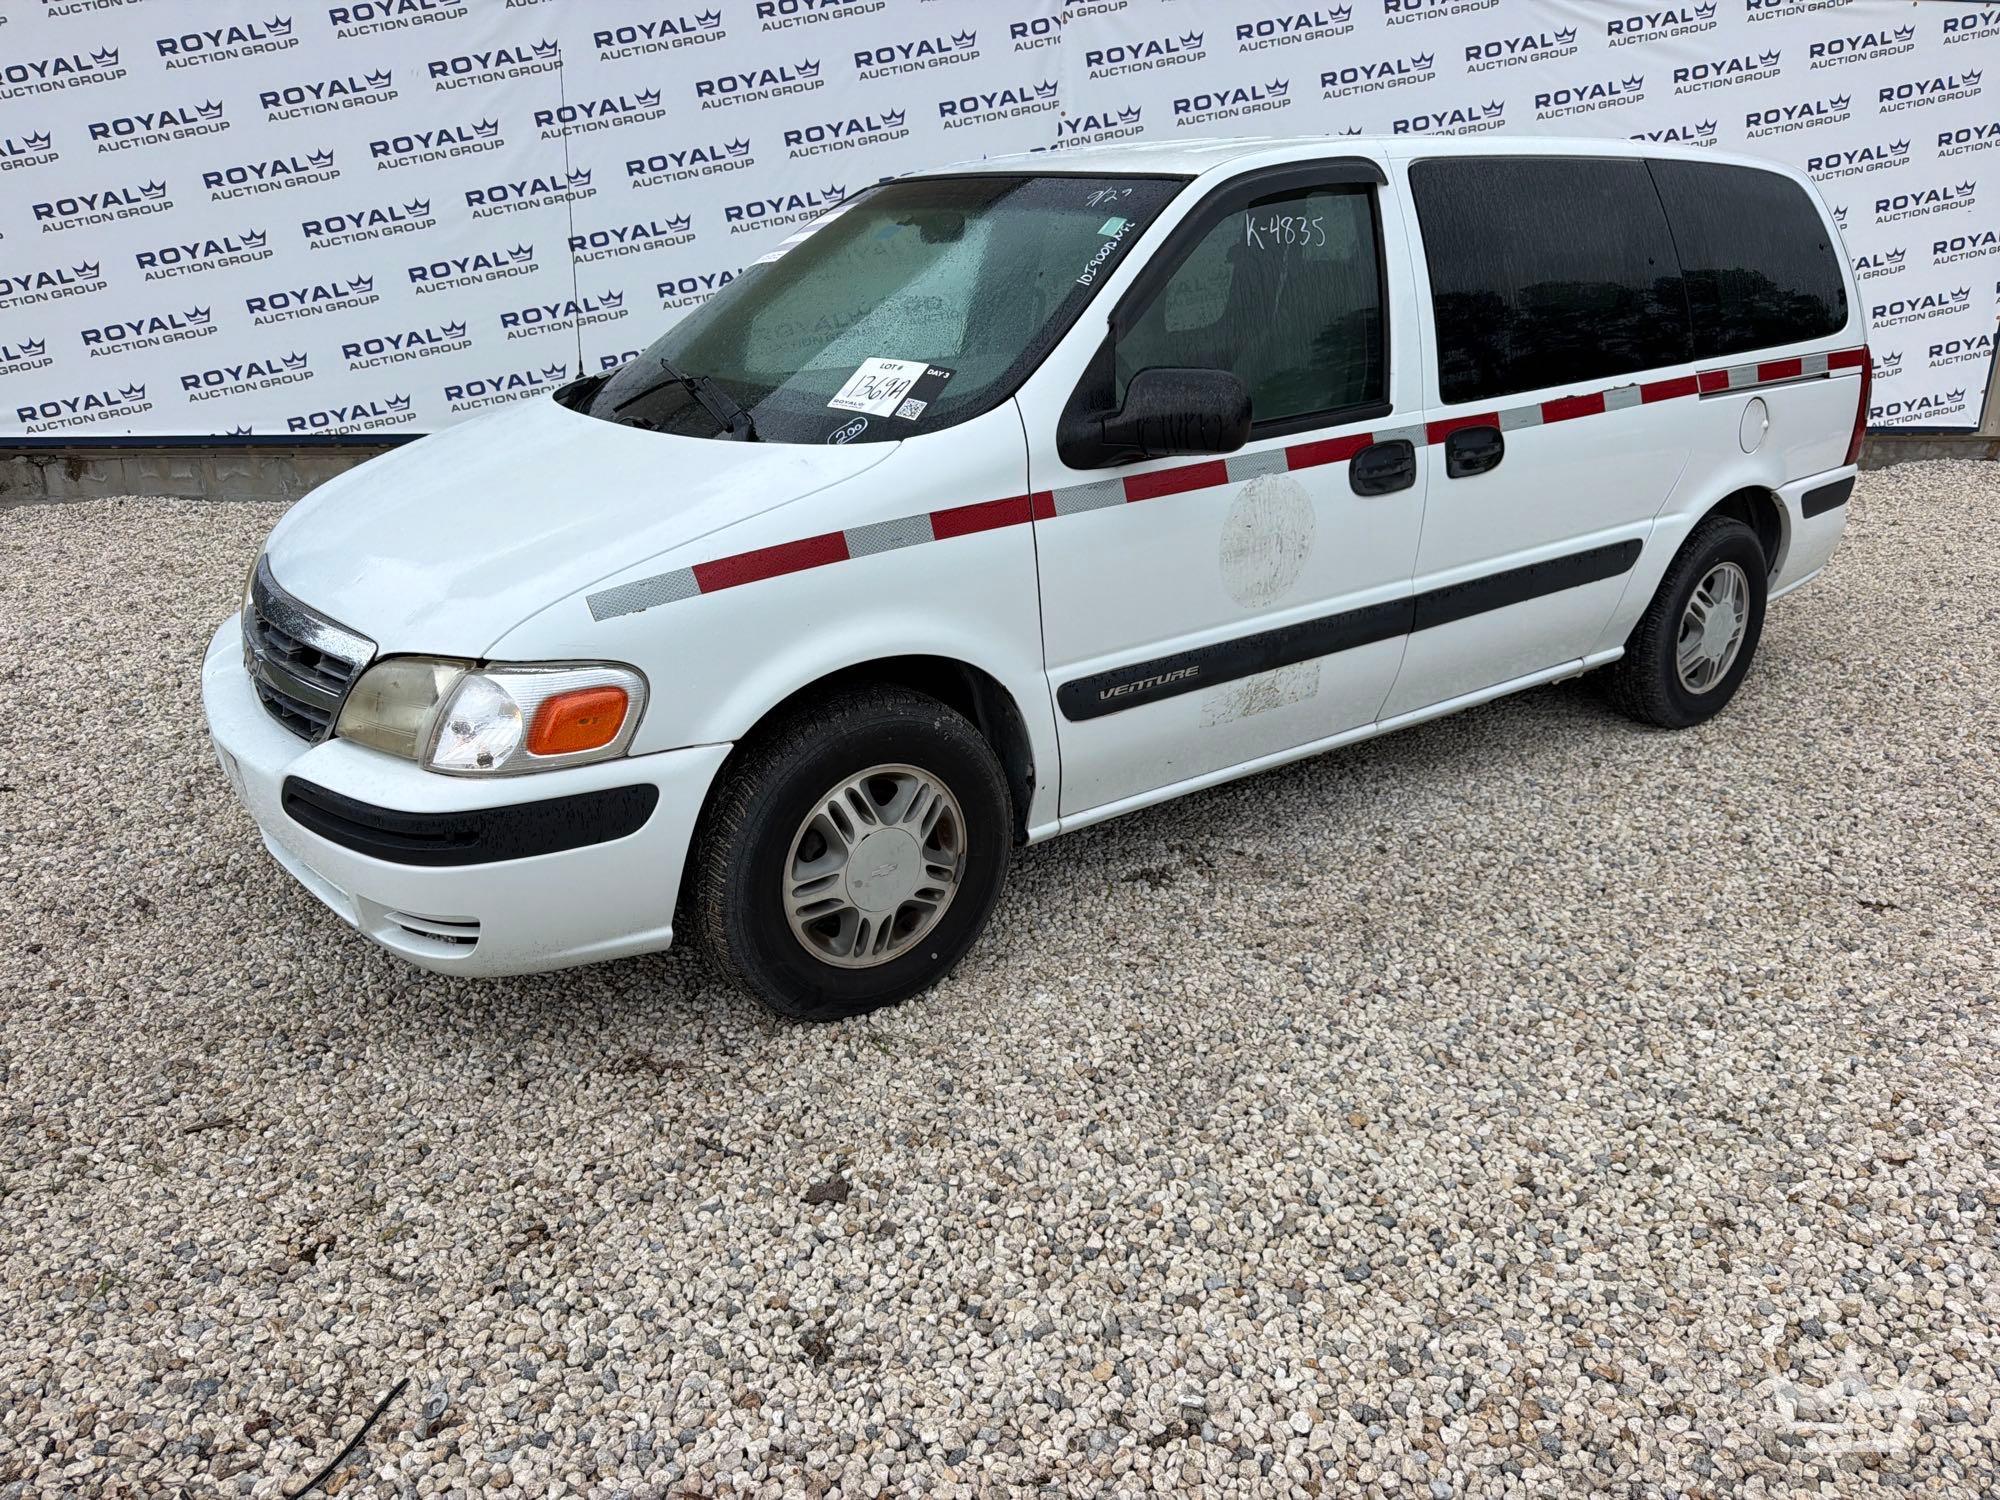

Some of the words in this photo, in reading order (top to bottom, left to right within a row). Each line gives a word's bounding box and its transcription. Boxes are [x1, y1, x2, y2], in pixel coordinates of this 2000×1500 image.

[336, 19, 409, 39] AUCTION
[412, 8, 468, 26] GROUP
[762, 12, 829, 32] AUCTION
[833, 2, 886, 20] GROUP
[1077, 1, 1128, 17] GROUP
[1386, 8, 1448, 26] AUCTION
[1451, 0, 1499, 15] GROUP
[1608, 6, 1697, 36] ROYAL
[1747, 5, 1805, 23] AUCTION
[156, 22, 268, 57] ROYAL
[593, 15, 698, 48] ROYAL
[1236, 10, 1331, 40] ROYAL
[1239, 34, 1302, 53] AUCTION
[1304, 24, 1354, 41] GROUP
[1608, 30, 1668, 48] AUCTION
[1670, 21, 1717, 36] GROUP
[166, 48, 239, 70] AUCTION
[241, 38, 299, 56] GROUP
[600, 41, 669, 62] AUCTION
[672, 30, 726, 48] GROUP
[854, 35, 954, 68] ROYAL
[1086, 36, 1182, 68] ROYAL
[1465, 32, 1556, 62] ROYAL
[1466, 55, 1528, 74] AUCTION
[1530, 46, 1578, 62] GROUP
[1810, 30, 1896, 59] ROYAL
[1810, 52, 1867, 70] AUCTION
[1870, 44, 1914, 59] GROUP
[428, 44, 534, 79] ROYAL
[436, 70, 506, 92] AUCTION
[508, 60, 564, 78] GROUP
[859, 60, 926, 81] AUCTION
[928, 50, 980, 68] GROUP
[1089, 60, 1153, 80] AUCTION
[1156, 51, 1206, 68] GROUP
[1320, 57, 1414, 88] ROYAL
[1674, 54, 1762, 84] ROYAL
[68, 69, 127, 87] GROUP
[259, 74, 368, 110] ROYAL
[696, 64, 798, 98] ROYAL
[1322, 81, 1384, 100] AUCTION
[1387, 72, 1436, 88] GROUP
[1674, 77, 1732, 96] AUCTION
[1735, 68, 1780, 84] GROUP
[1879, 74, 1964, 103] ROYAL
[268, 101, 340, 122] AUCTION
[342, 90, 398, 108] GROUP
[702, 90, 769, 110] AUCTION
[771, 80, 824, 97] GROUP
[938, 85, 1036, 118] ROYAL
[1174, 84, 1268, 115] ROYAL
[1534, 80, 1624, 109] ROYAL
[1536, 102, 1596, 121] AUCTION
[1598, 94, 1644, 110] GROUP
[1879, 96, 1936, 114] AUCTION
[1938, 88, 1982, 103] GROUP
[88, 106, 199, 140] ROYAL
[534, 94, 638, 128] ROYAL
[541, 120, 610, 140] AUCTION
[612, 109, 666, 127] GROUP
[944, 110, 1008, 130] AUCTION
[1176, 108, 1239, 127] AUCTION
[1242, 98, 1291, 114] GROUP
[1393, 107, 1481, 134] ROYAL
[1746, 99, 1832, 128] ROYAL
[1746, 122, 1804, 140] AUCTION
[1806, 112, 1850, 128] GROUP
[98, 132, 170, 154] AUCTION
[172, 121, 230, 140] GROUP
[369, 124, 475, 158] ROYAL
[784, 114, 884, 147] ROYAL
[1094, 125, 1144, 142] GROUP
[1458, 120, 1506, 135] GROUP
[378, 150, 447, 171] AUCTION
[450, 139, 504, 157] GROUP
[789, 139, 855, 159] AUCTION
[858, 128, 910, 146] GROUP
[1808, 144, 1892, 172] ROYAL
[1937, 140, 1993, 158] AUCTION
[1, 153, 59, 171] GROUP
[202, 154, 310, 189] ROYAL
[626, 144, 728, 176] ROYAL
[632, 168, 699, 189] AUCTION
[702, 158, 754, 176] GROUP
[1866, 157, 1910, 172] GROUP
[211, 180, 282, 202] AUCTION
[284, 170, 340, 188] GROUP
[464, 172, 568, 207] ROYAL
[1875, 186, 1958, 214] ROYAL
[32, 186, 142, 221] ROYAL
[42, 212, 114, 234] AUCTION
[116, 201, 174, 219] GROUP
[472, 198, 540, 220] AUCTION
[542, 188, 597, 206] GROUP
[725, 192, 822, 222] ROYAL
[1875, 207, 1930, 224] AUCTION
[1932, 198, 1976, 213] GROUP
[302, 204, 407, 238] ROYAL
[310, 230, 380, 250] AUCTION
[382, 218, 436, 236] GROUP
[568, 220, 668, 253] ROYAL
[730, 214, 796, 234] AUCTION
[1245, 211, 1326, 249] K-4835
[136, 235, 243, 270] ROYAL
[573, 244, 641, 266] AUCTION
[643, 234, 696, 251] GROUP
[1933, 249, 1987, 266] AUCTION
[145, 260, 216, 282] AUCTION
[218, 250, 274, 268] GROUP
[408, 250, 510, 283] ROYAL
[416, 274, 483, 295] AUCTION
[486, 264, 539, 281] GROUP
[1863, 265, 1906, 280] GROUP
[51, 281, 108, 299] GROUP
[246, 280, 350, 314] ROYAL
[254, 306, 323, 326] AUCTION
[325, 294, 380, 312] GROUP
[500, 296, 601, 328] ROYAL
[1872, 292, 1953, 320] ROYAL
[1872, 312, 1926, 330] AUCTION
[1928, 303, 1970, 318] GROUP
[80, 312, 188, 346] ROYAL
[507, 320, 574, 340] AUCTION
[576, 309, 628, 329] GROUP
[90, 336, 160, 358] AUCTION
[162, 326, 218, 344] GROUP
[342, 326, 444, 360] ROYAL
[350, 350, 417, 371] AUCTION
[418, 340, 472, 358] GROUP
[180, 358, 284, 391] ROYAL
[927, 368, 944, 377] DAY
[1929, 350, 1981, 368] AUCTION
[189, 382, 258, 402] AUCTION
[260, 371, 314, 388] GROUP
[444, 368, 544, 402] ROYAL
[16, 389, 122, 423] ROYAL
[26, 414, 96, 434] AUCTION
[98, 402, 153, 420] GROUP
[287, 401, 388, 432] ROYAL
[451, 392, 518, 413] AUCTION
[1870, 395, 1945, 420] ROYAL
[1925, 404, 1965, 418] GROUP
[364, 413, 417, 430] GROUP
[1100, 665, 1200, 700] VENTURE
